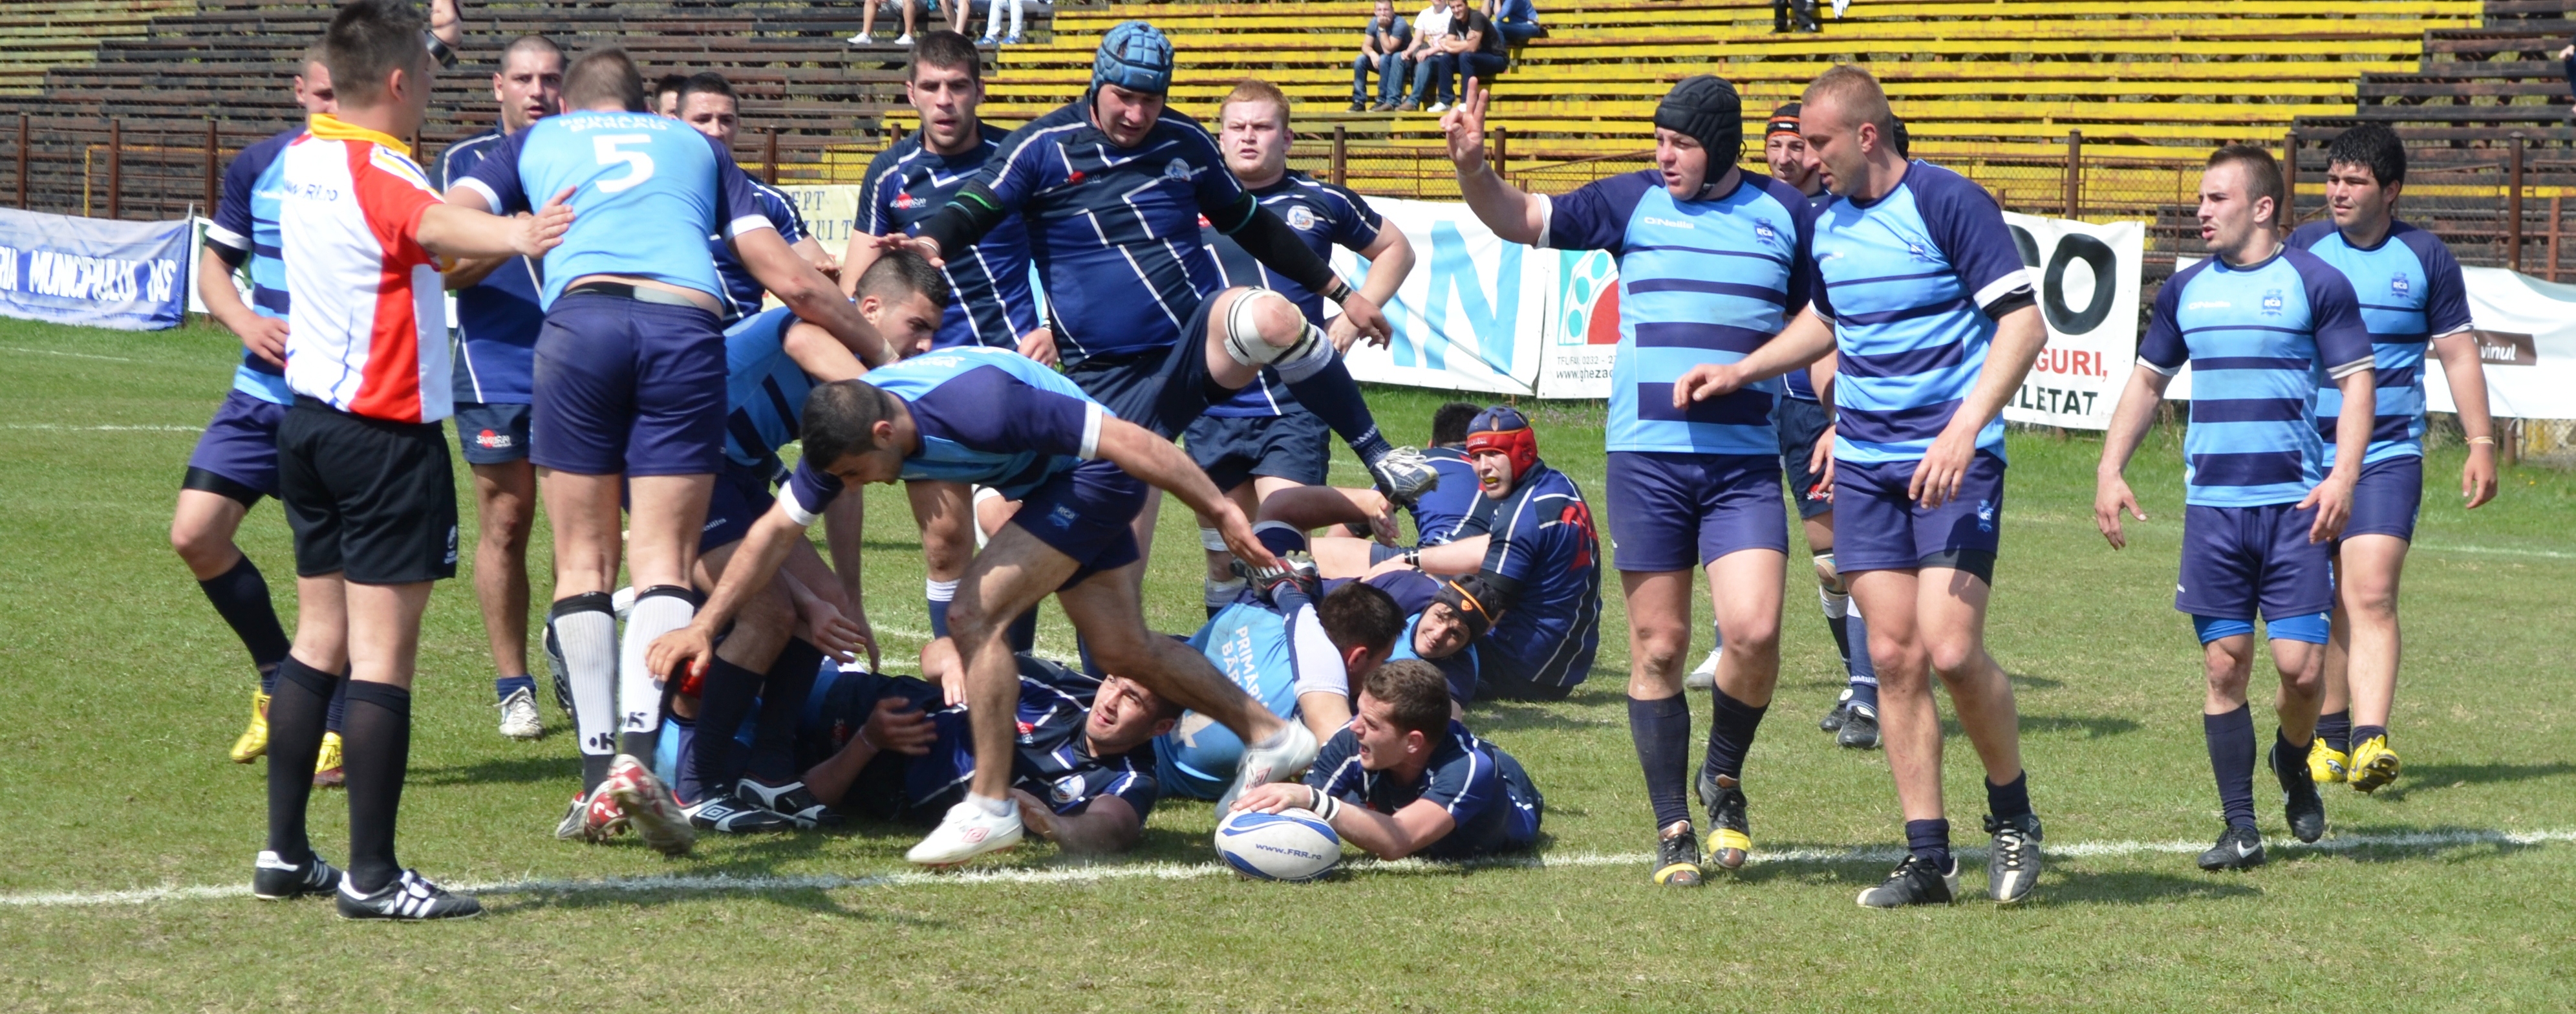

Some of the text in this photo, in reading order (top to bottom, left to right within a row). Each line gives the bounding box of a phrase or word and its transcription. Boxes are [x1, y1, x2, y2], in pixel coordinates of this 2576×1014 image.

[592, 134, 654, 193] 5
[785, 190, 825, 211] EPT
[1644, 216, 1694, 229] O'Neills
[1582, 356, 1598, 365] 0232
[2031, 348, 2108, 383] GURI,
[2007, 385, 2098, 416] LETAT
[1255, 843, 1322, 861] www.FRR.ro
